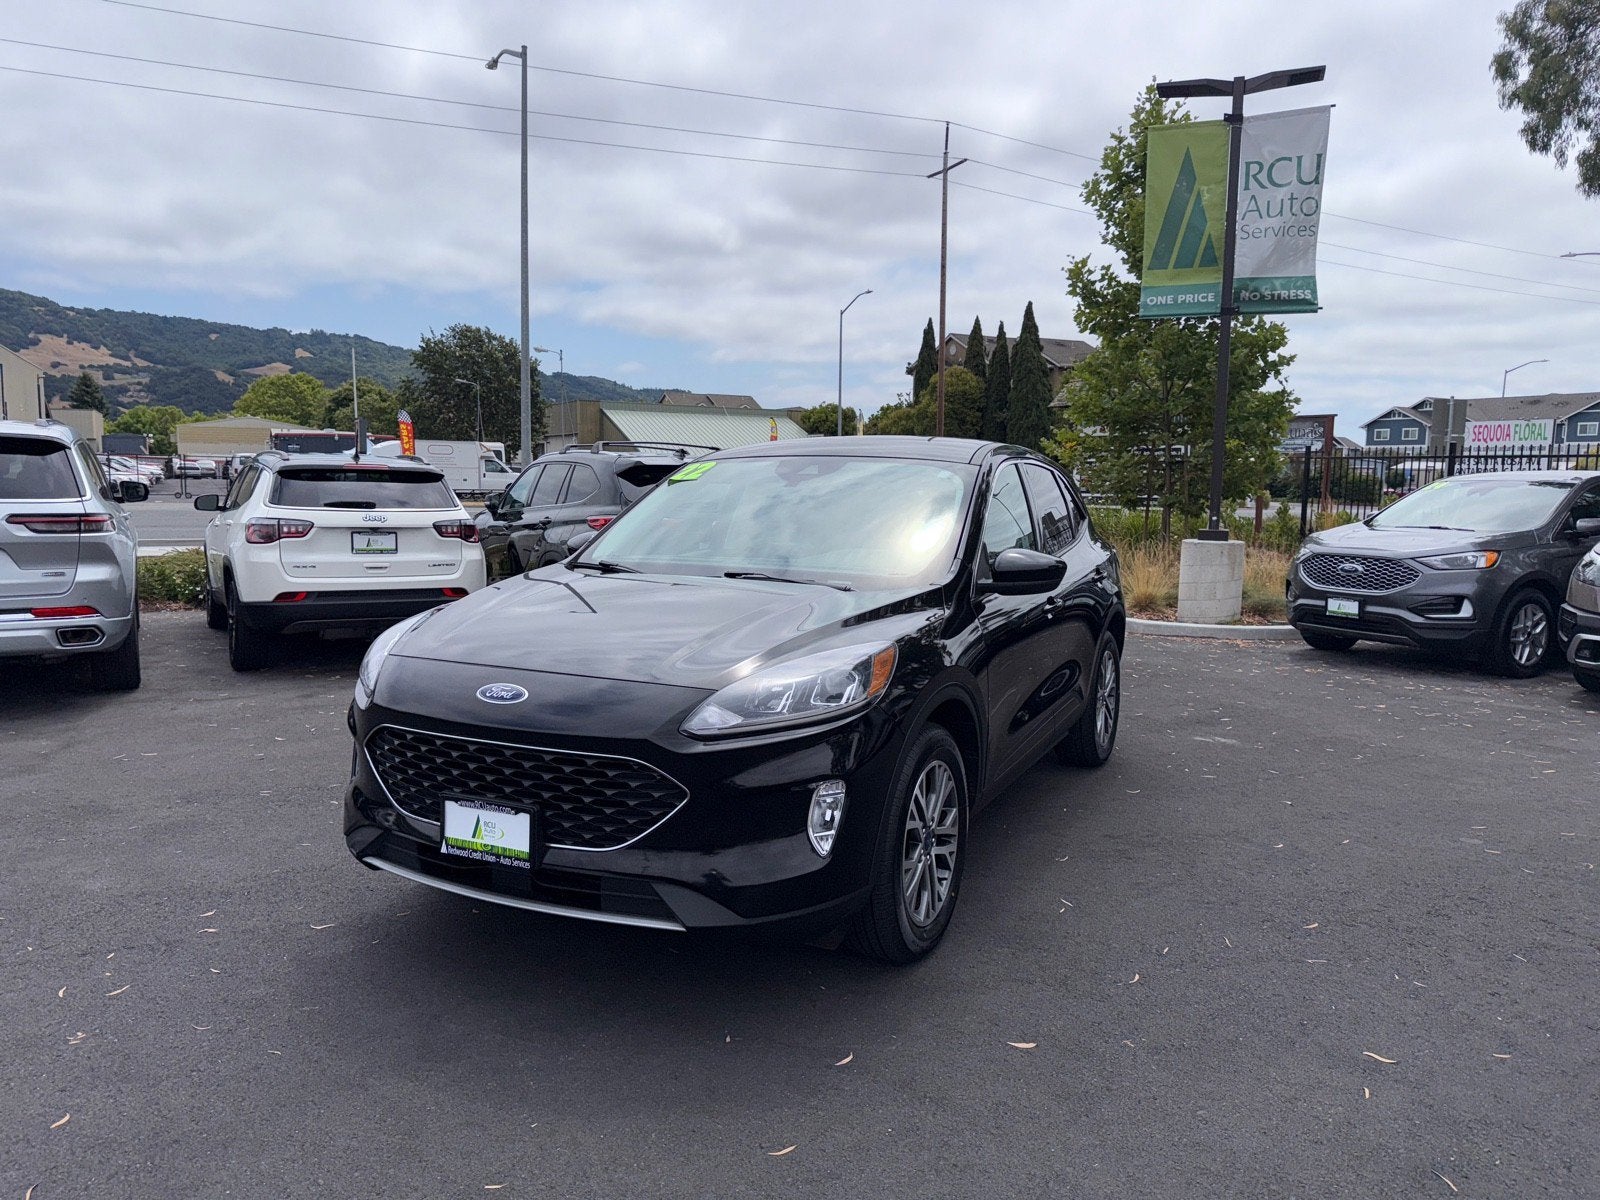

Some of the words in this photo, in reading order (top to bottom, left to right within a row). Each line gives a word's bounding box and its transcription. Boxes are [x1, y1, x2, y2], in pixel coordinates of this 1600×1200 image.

[1243, 153, 1323, 191] RCU
[1241, 192, 1319, 221] Auto
[1240, 222, 1316, 240] Services
[1146, 294, 1174, 306] ONE
[1178, 292, 1215, 304] PRICE
[1239, 289, 1260, 301] NO
[1264, 289, 1312, 300] STRESS
[1472, 423, 1511, 443] SEQUOIA
[1513, 422, 1548, 441] FLORAL
[362, 513, 388, 524] Jeep
[486, 685, 518, 699] Ford
[447, 845, 469, 858] Redwood
[469, 849, 482, 859] Credit
[482, 851, 497, 862] Union
[500, 855, 512, 866] Auto
[512, 857, 531, 869] Services
